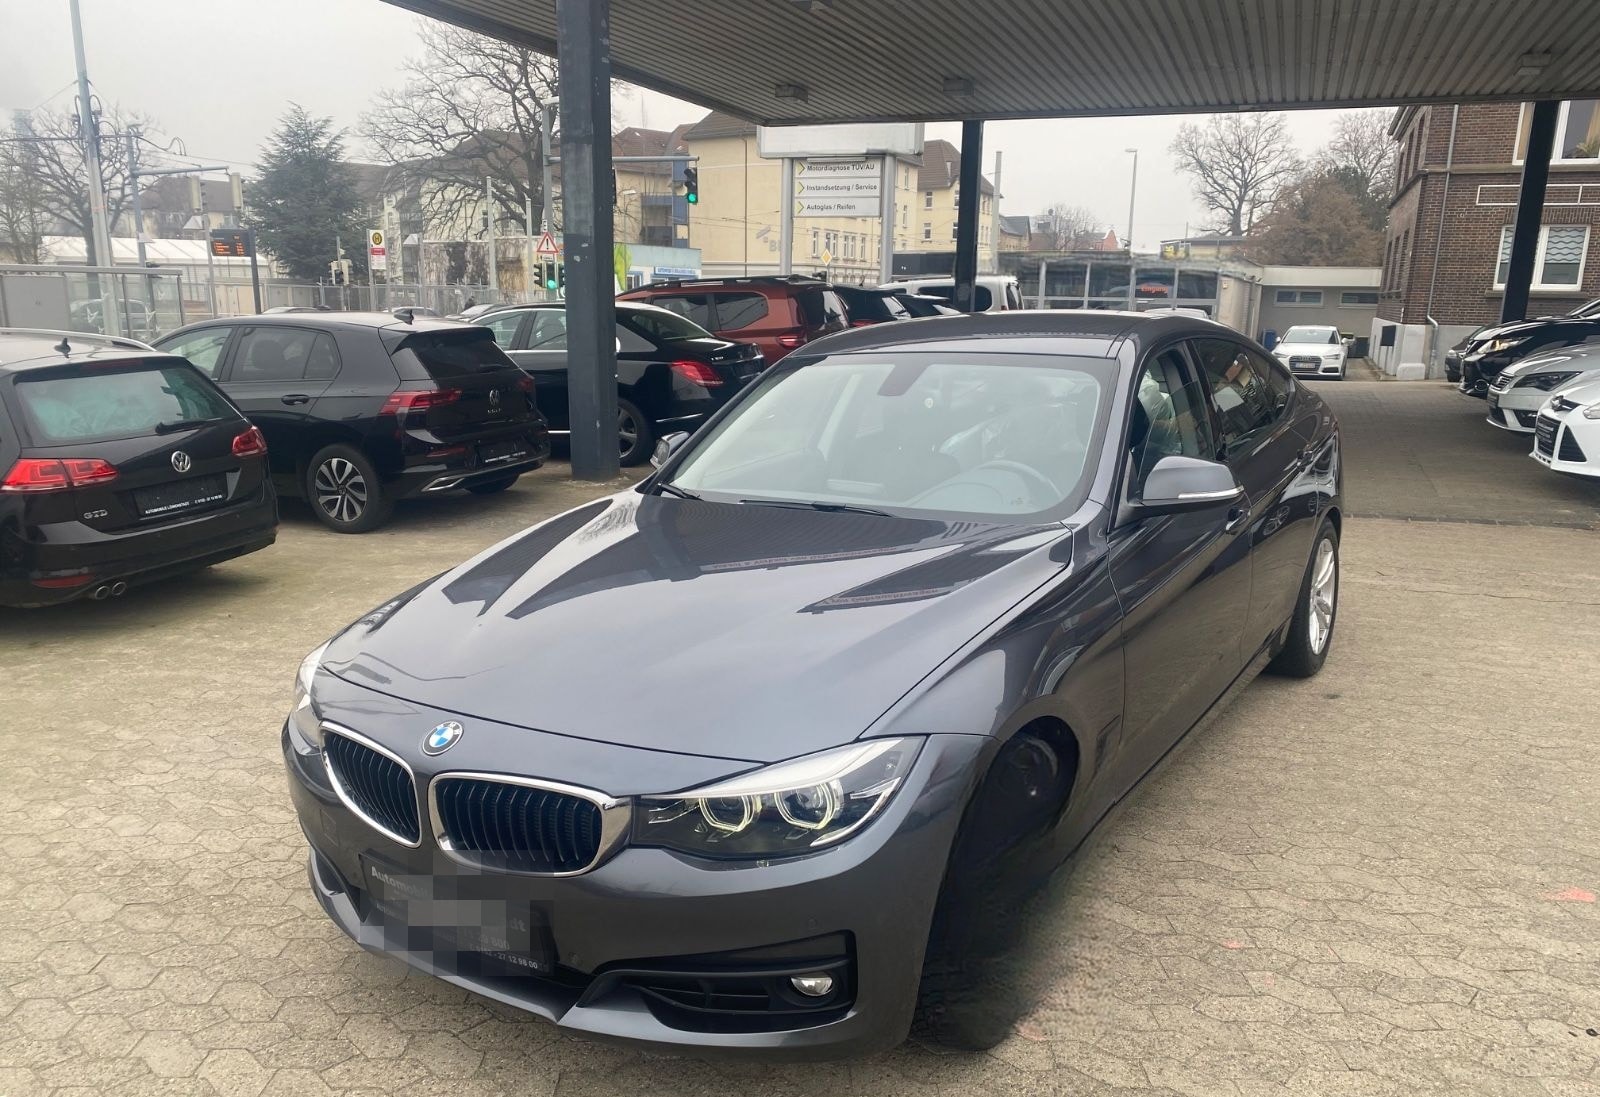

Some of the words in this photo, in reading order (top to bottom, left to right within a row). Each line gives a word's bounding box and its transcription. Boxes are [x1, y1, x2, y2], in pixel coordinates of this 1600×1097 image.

[806, 184, 851, 192] Instandsetzung
[371, 865, 433, 897] Automobil
[528, 960, 539, 969] 00
